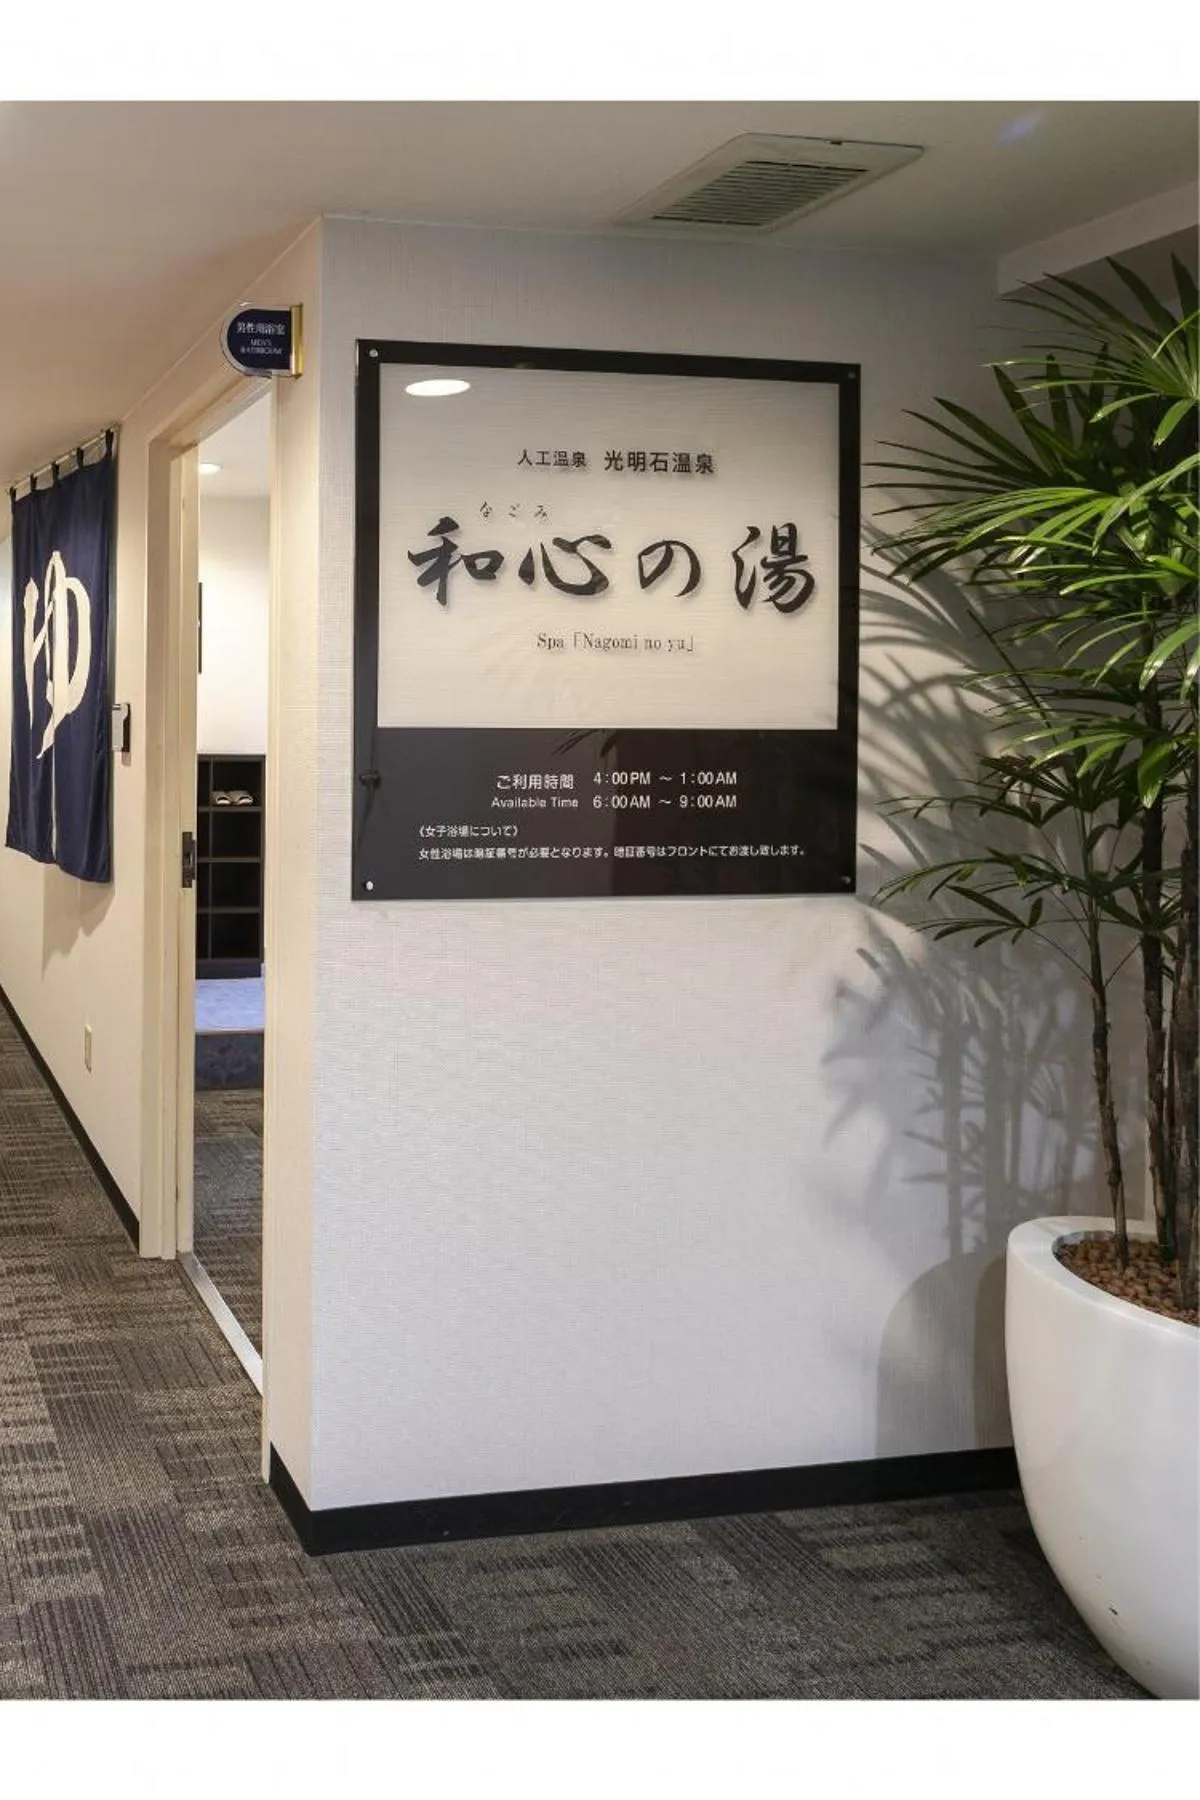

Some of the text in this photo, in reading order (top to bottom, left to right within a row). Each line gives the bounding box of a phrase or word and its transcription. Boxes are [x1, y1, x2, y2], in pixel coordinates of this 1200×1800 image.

[517, 449, 714, 474] 人工温泉 光明石温泉
[408, 516, 816, 614] 和心の湯
[537, 632, 564, 650] Spa
[644, 638, 661, 649] no
[497, 773, 574, 790] ご利用時間
[491, 796, 546, 808] Available
[550, 797, 579, 808] Time
